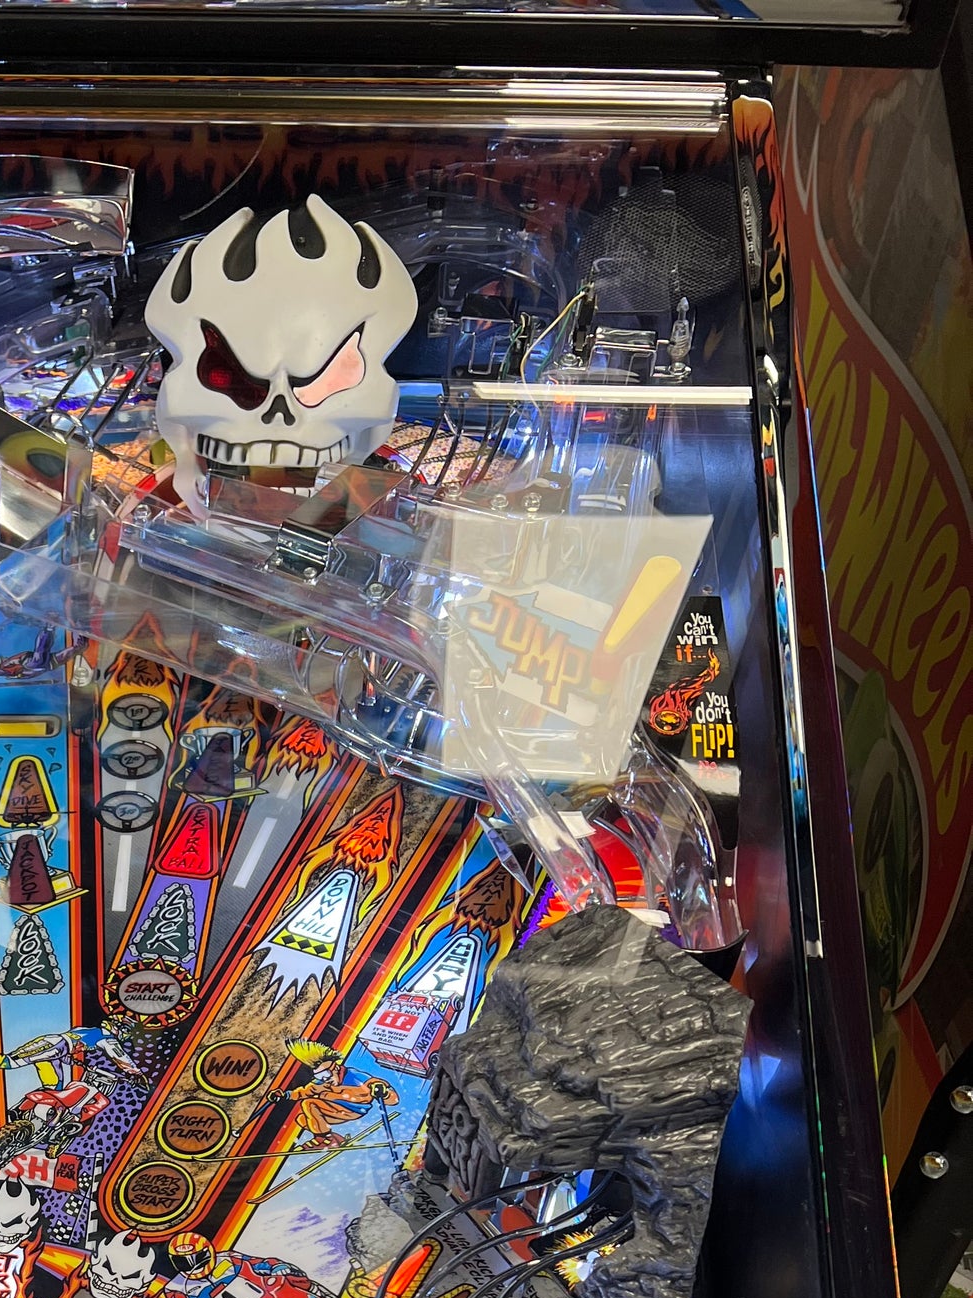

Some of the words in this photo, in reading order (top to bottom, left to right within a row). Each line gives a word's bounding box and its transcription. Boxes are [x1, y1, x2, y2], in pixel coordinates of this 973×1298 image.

[677, 635, 719, 646] win
[468, 592, 593, 707] JUMP
[12, 795, 41, 806] DIVE
[182, 809, 206, 856] EXTRA
[311, 878, 349, 920] DOWN
[146, 889, 184, 952] LOCK
[294, 918, 335, 938] HILL
[14, 922, 49, 987] LOCK
[124, 982, 177, 995] START
[123, 993, 176, 1002] CHALLENGE
[207, 1056, 257, 1077] WIN!
[170, 1115, 220, 1128] RIGHT
[169, 1128, 215, 1142] TURN
[60, 1162, 76, 1170] NO
[57, 1169, 76, 1180] FEAR
[137, 1173, 182, 1185] SUPER
[131, 1183, 180, 1195] CROSS
[130, 1194, 175, 1209] START
